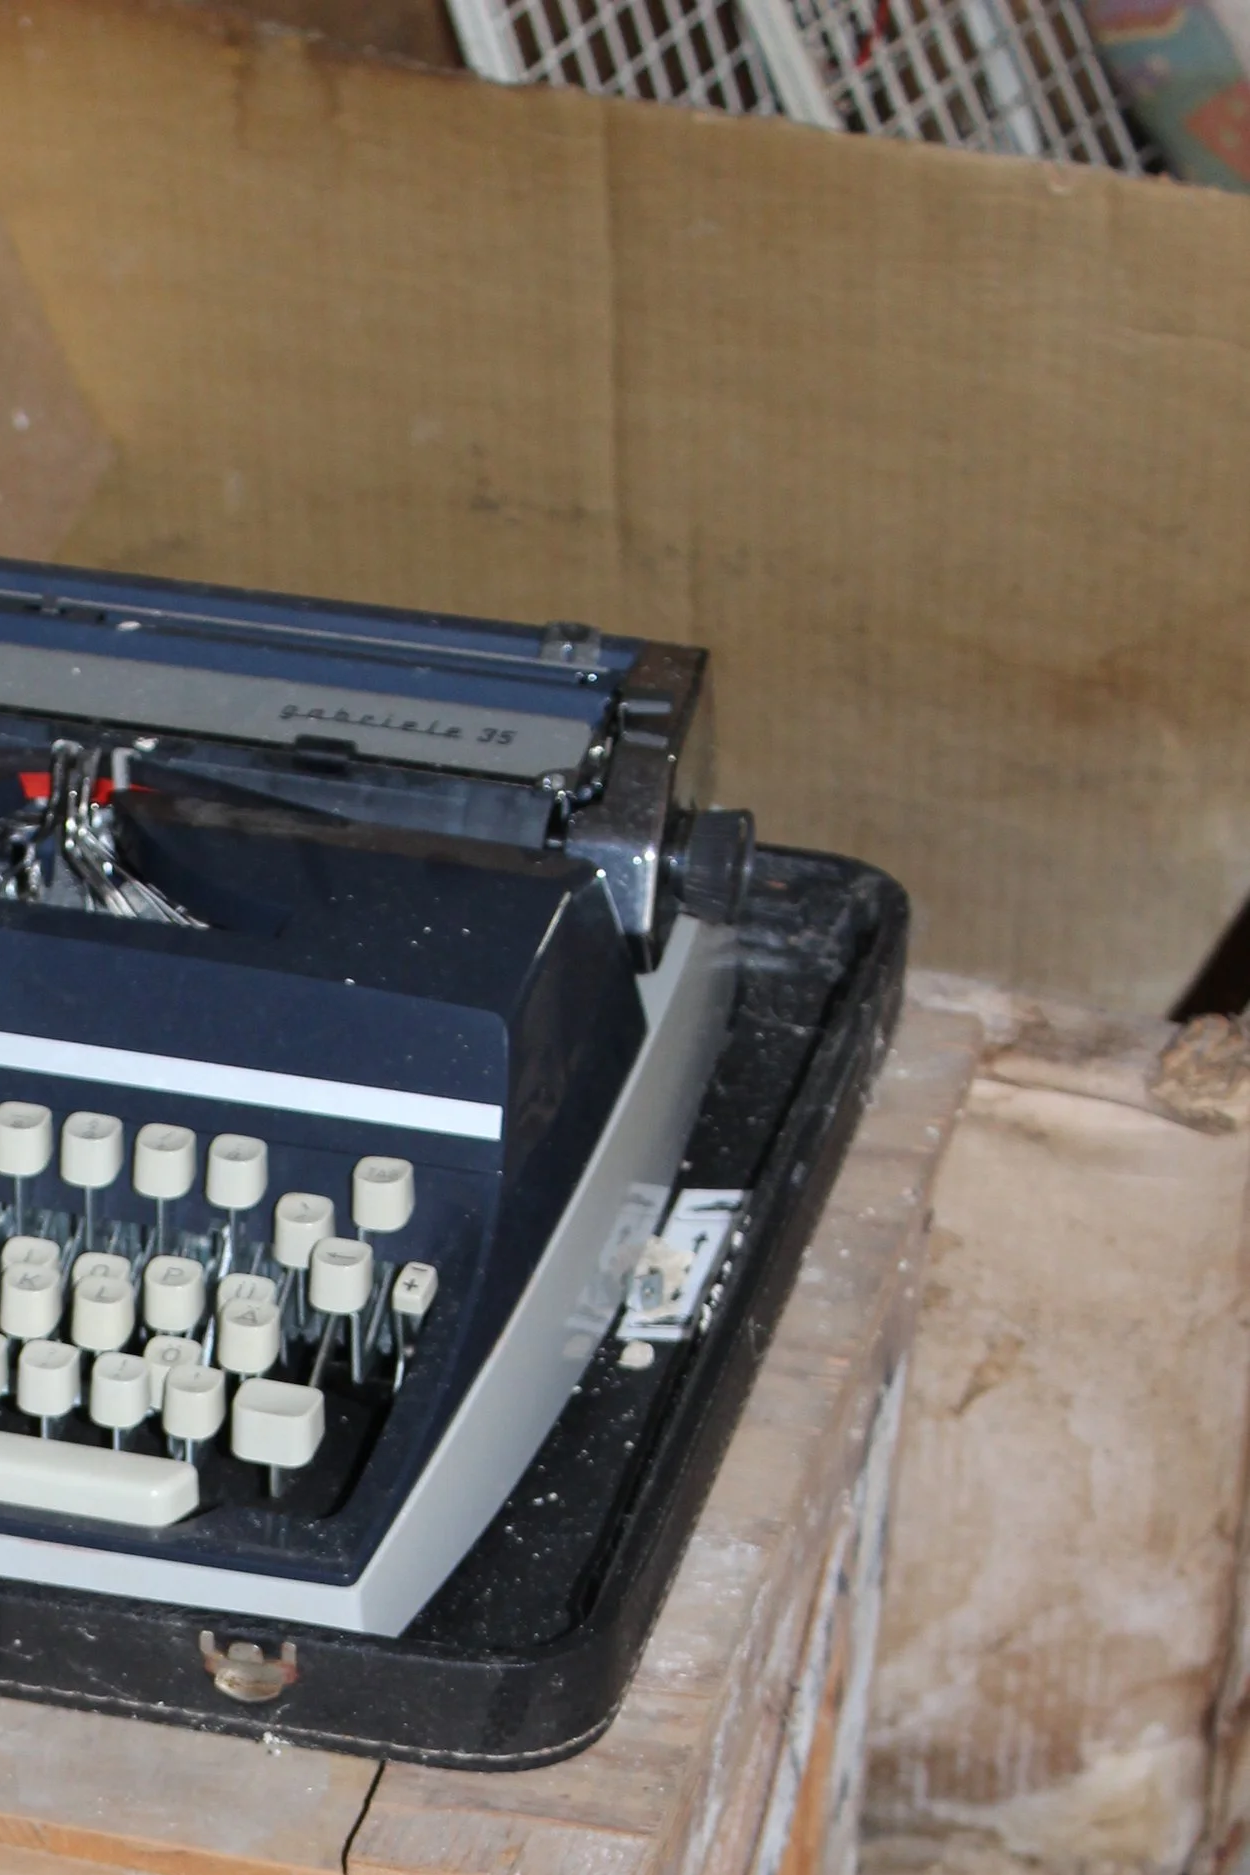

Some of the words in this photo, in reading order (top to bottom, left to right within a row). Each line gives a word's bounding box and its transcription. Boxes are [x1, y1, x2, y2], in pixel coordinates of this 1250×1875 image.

[280, 704, 462, 740] gabriele
[18, 1272, 41, 1290] K
[161, 1266, 184, 1282] P
